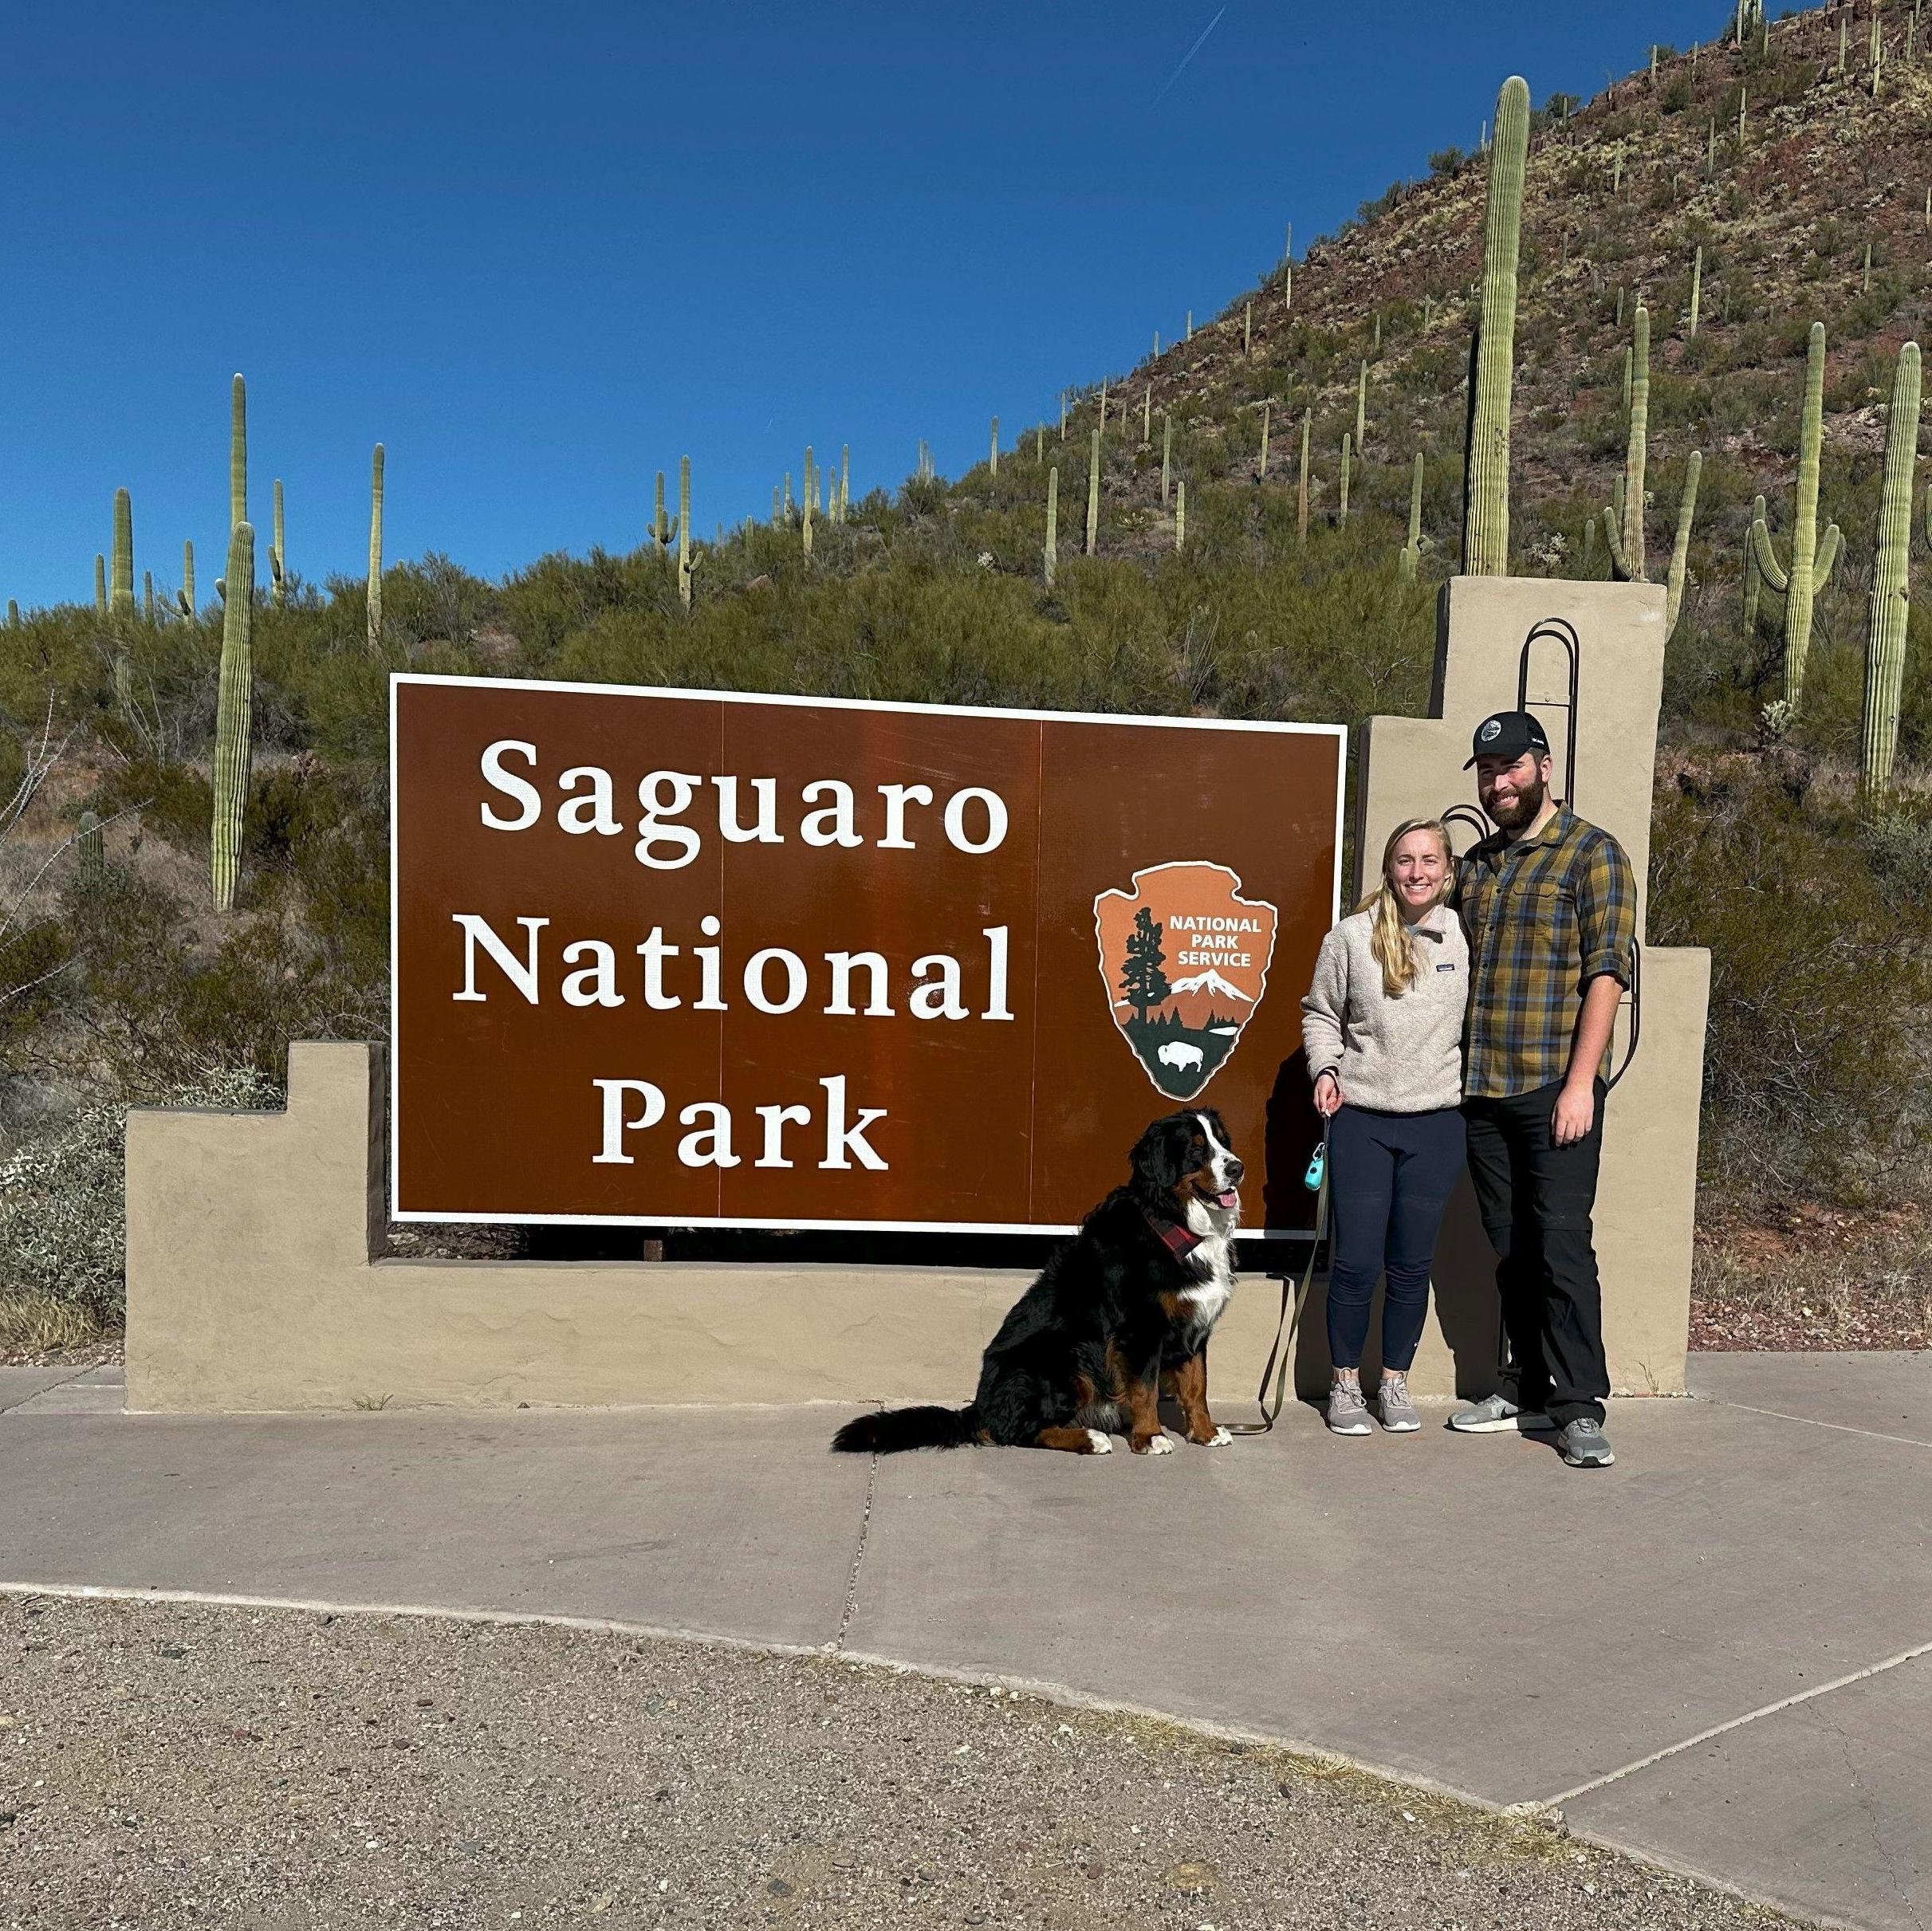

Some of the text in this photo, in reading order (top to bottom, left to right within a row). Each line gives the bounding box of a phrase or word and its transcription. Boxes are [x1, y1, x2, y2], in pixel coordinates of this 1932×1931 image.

[481, 739, 1009, 870] Saguaro
[1170, 915, 1262, 933] NATIONAL
[1191, 934, 1239, 950] PARK
[452, 914, 1014, 1021] National
[1178, 950, 1251, 967] SERVICE
[592, 1074, 889, 1170] Park
